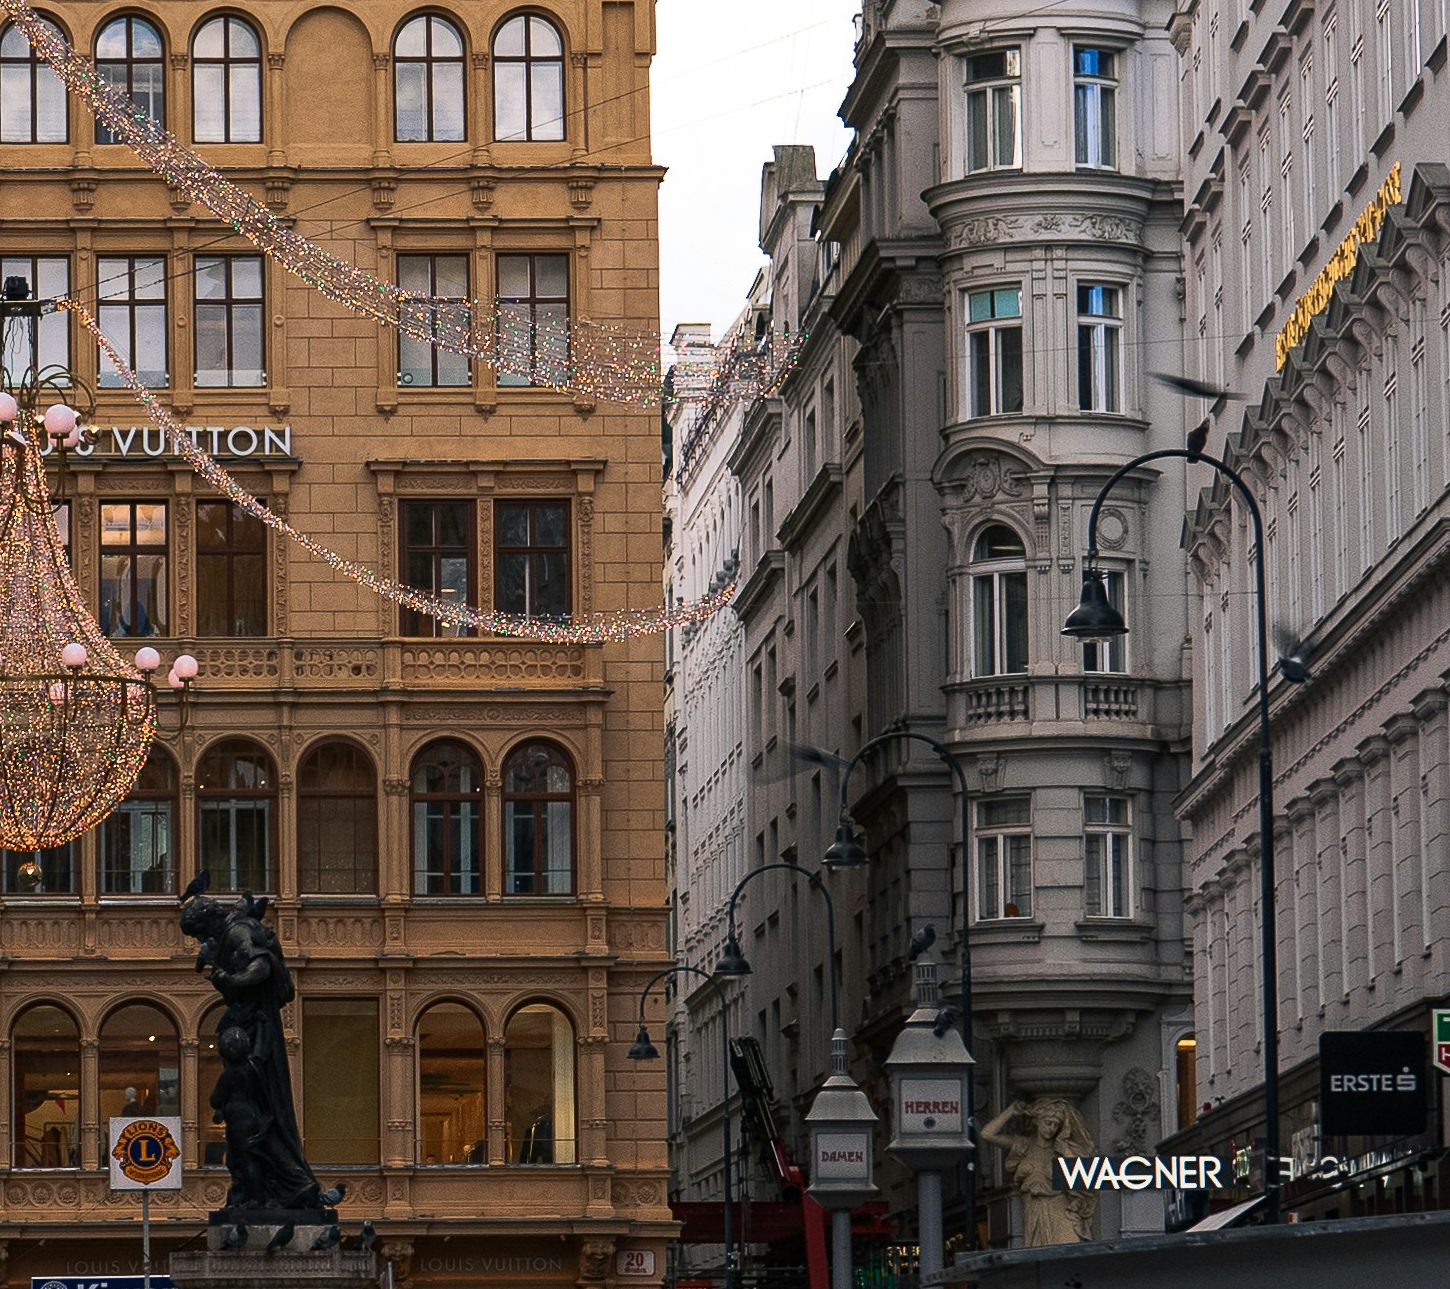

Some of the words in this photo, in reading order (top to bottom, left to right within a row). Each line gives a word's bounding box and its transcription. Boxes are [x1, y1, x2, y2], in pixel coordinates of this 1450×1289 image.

[1330, 1074, 1395, 1093] ERSTE
[904, 1101, 959, 1114] HERREN
[126, 1121, 168, 1137] LIONS
[139, 1139, 156, 1161] L
[821, 1151, 863, 1162] DAMEN
[1057, 1155, 1223, 1190] WAGNER
[66, 1259, 121, 1274] LOUIS
[420, 1258, 474, 1272] LOUIS
[478, 1257, 563, 1272] VUITTON
[625, 1252, 644, 1267] 20
